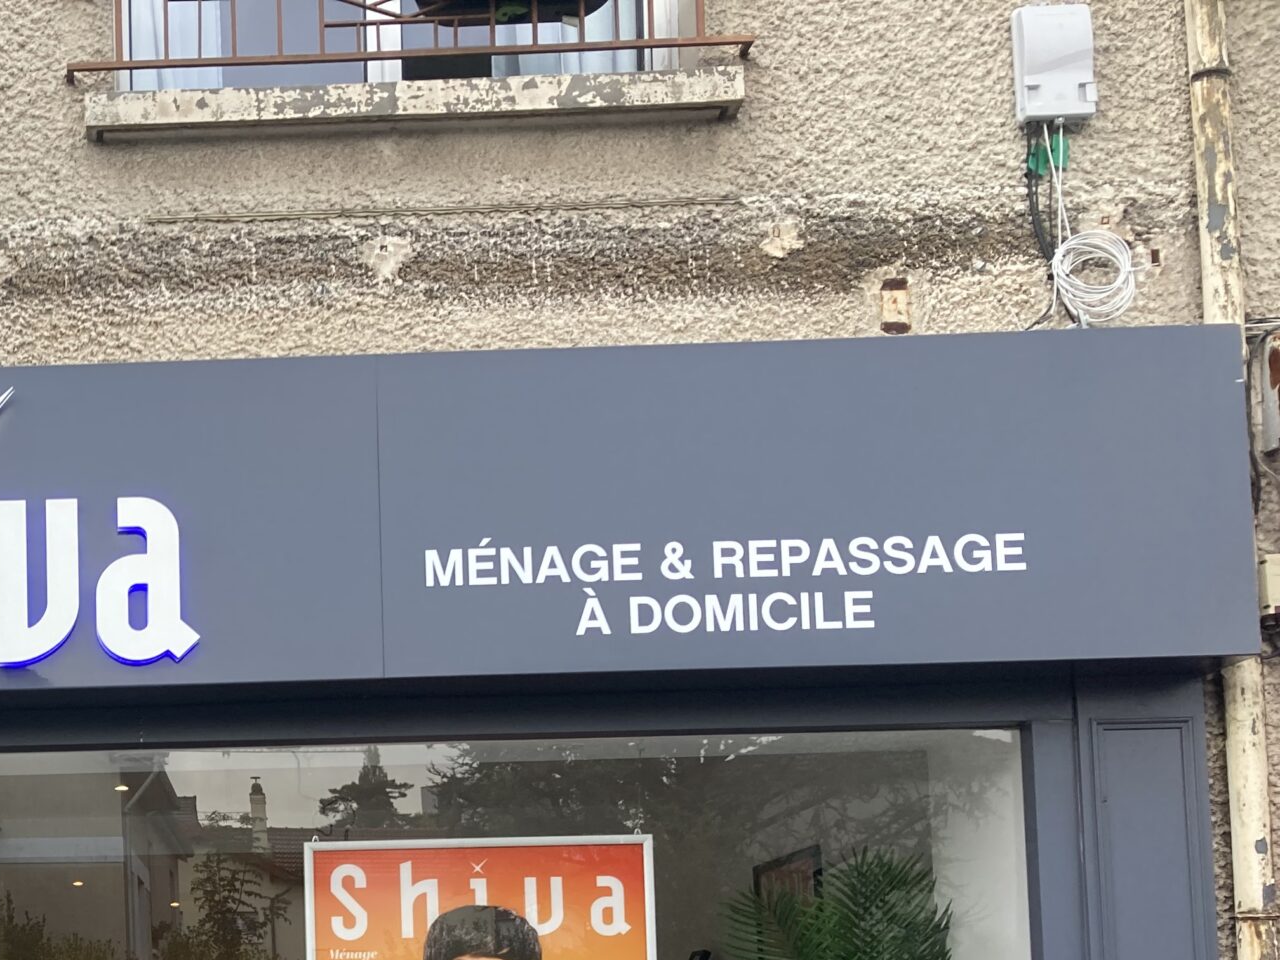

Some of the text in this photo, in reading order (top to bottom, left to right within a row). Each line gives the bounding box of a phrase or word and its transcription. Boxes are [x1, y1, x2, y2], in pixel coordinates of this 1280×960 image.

[424, 532, 1028, 588] MÉNAGE & REPASSAGE
[575, 587, 876, 636] À DOMICILE
[329, 948, 378, 960] Ménage
